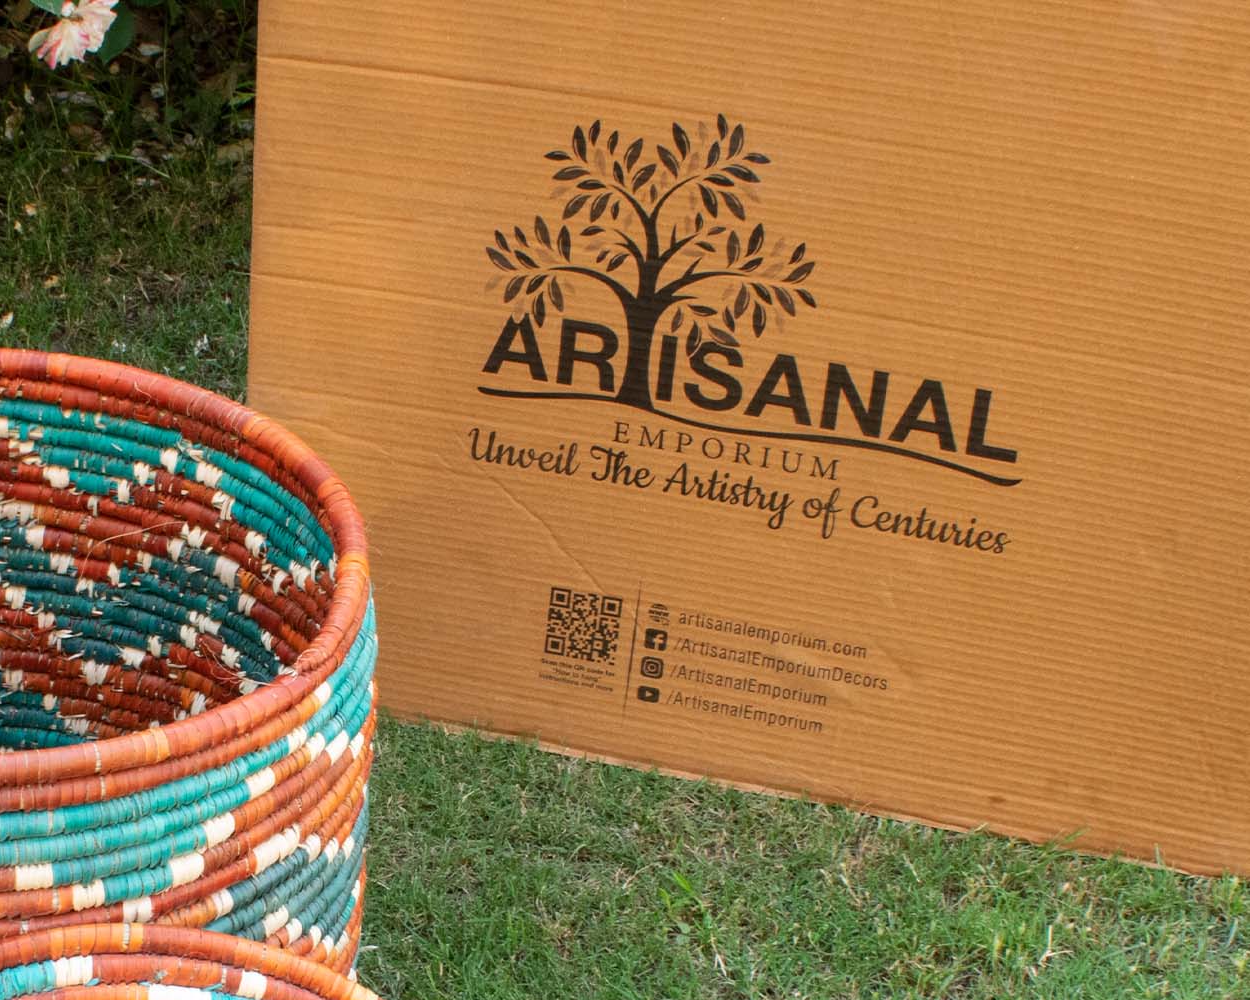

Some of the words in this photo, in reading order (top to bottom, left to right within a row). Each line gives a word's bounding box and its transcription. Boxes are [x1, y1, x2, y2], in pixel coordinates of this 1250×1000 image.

[612, 421, 840, 480] EMPORIUM
[468, 428, 581, 475] Unveil
[590, 445, 655, 488] The
[662, 463, 794, 530] Artistry
[802, 487, 843, 539] of
[851, 496, 1011, 553] Centuries
[679, 611, 867, 659] artisanalemporium.com
[670, 664, 827, 707] /ArtisanalEmporium
[674, 637, 888, 690] /ArtisanalEmporiumDecors
[666, 690, 823, 733] /ArtisanalEmporium
